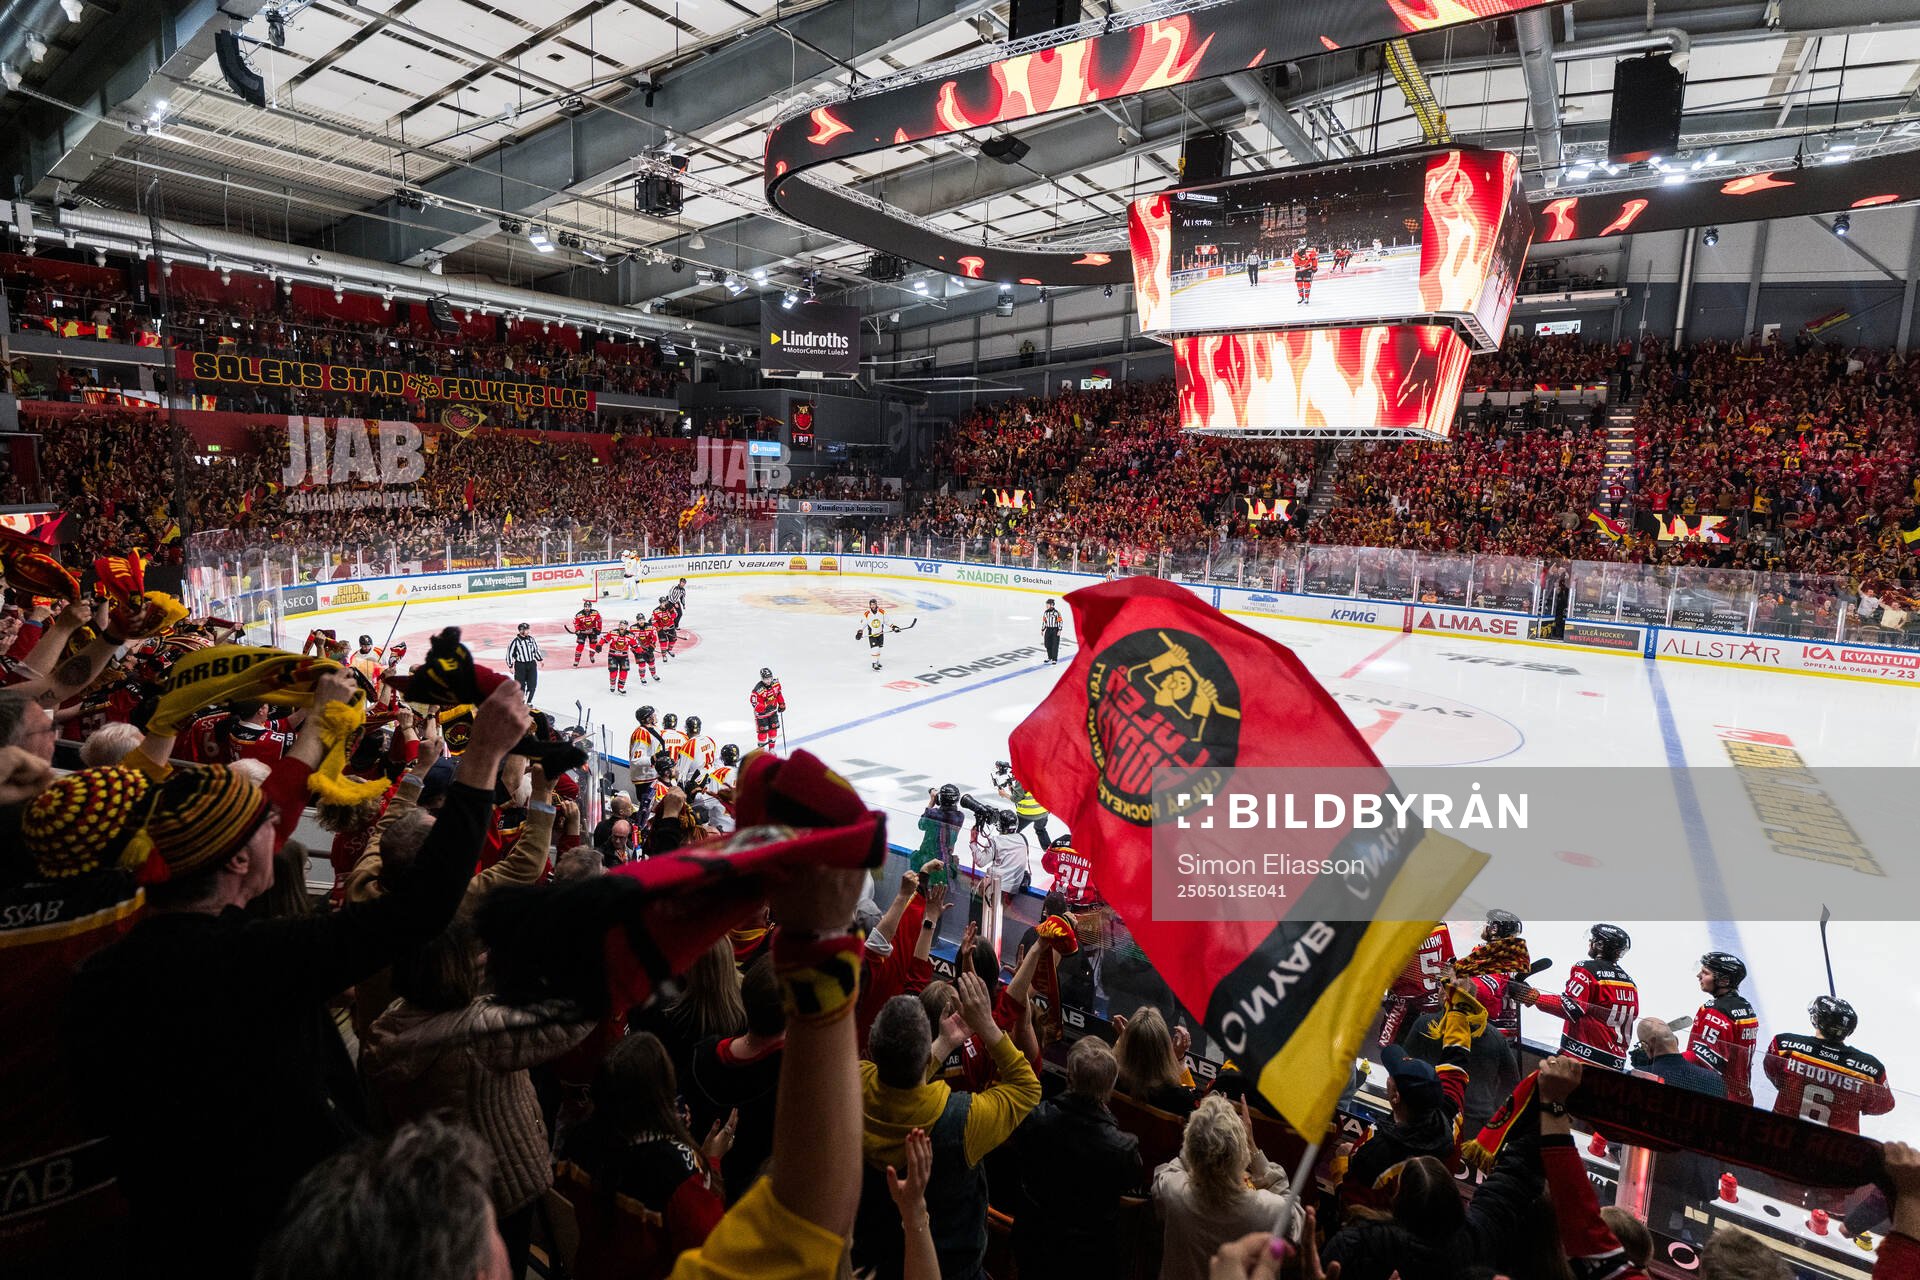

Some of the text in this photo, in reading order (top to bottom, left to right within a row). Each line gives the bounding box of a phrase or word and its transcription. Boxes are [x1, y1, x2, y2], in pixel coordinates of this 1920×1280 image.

[783, 330, 848, 349] Lindroths
[787, 347, 826, 356] MotorCenter
[193, 352, 588, 411] SOLENS STAD FOLKETS LAG
[282, 415, 425, 487] JIAB
[690, 436, 792, 490] JIAB
[532, 568, 584, 581] BORGA
[855, 558, 889, 572] winpos
[914, 561, 942, 573] YBT
[337, 584, 363, 595] EURO
[411, 583, 462, 592] Arvidssons
[1331, 609, 1377, 623] KPMG
[1578, 628, 1625, 639] LULEÅ HOCKEY
[1663, 638, 1779, 664] ALLSTAR
[1802, 646, 1916, 667] ICA KVANTUM
[1803, 661, 1826, 669] ÖPPET
[1880, 668, 1916, 680] 7-23
[1056, 863, 1089, 900] 34
[0, 900, 64, 928] SSAB
[1568, 980, 1585, 997] 40
[1701, 1025, 1721, 1045] 15
[1567, 1041, 1592, 1058] SSAB
[1788, 1041, 1878, 1075] LKAB SSAB LKAB
[1799, 1083, 1836, 1127] 6
